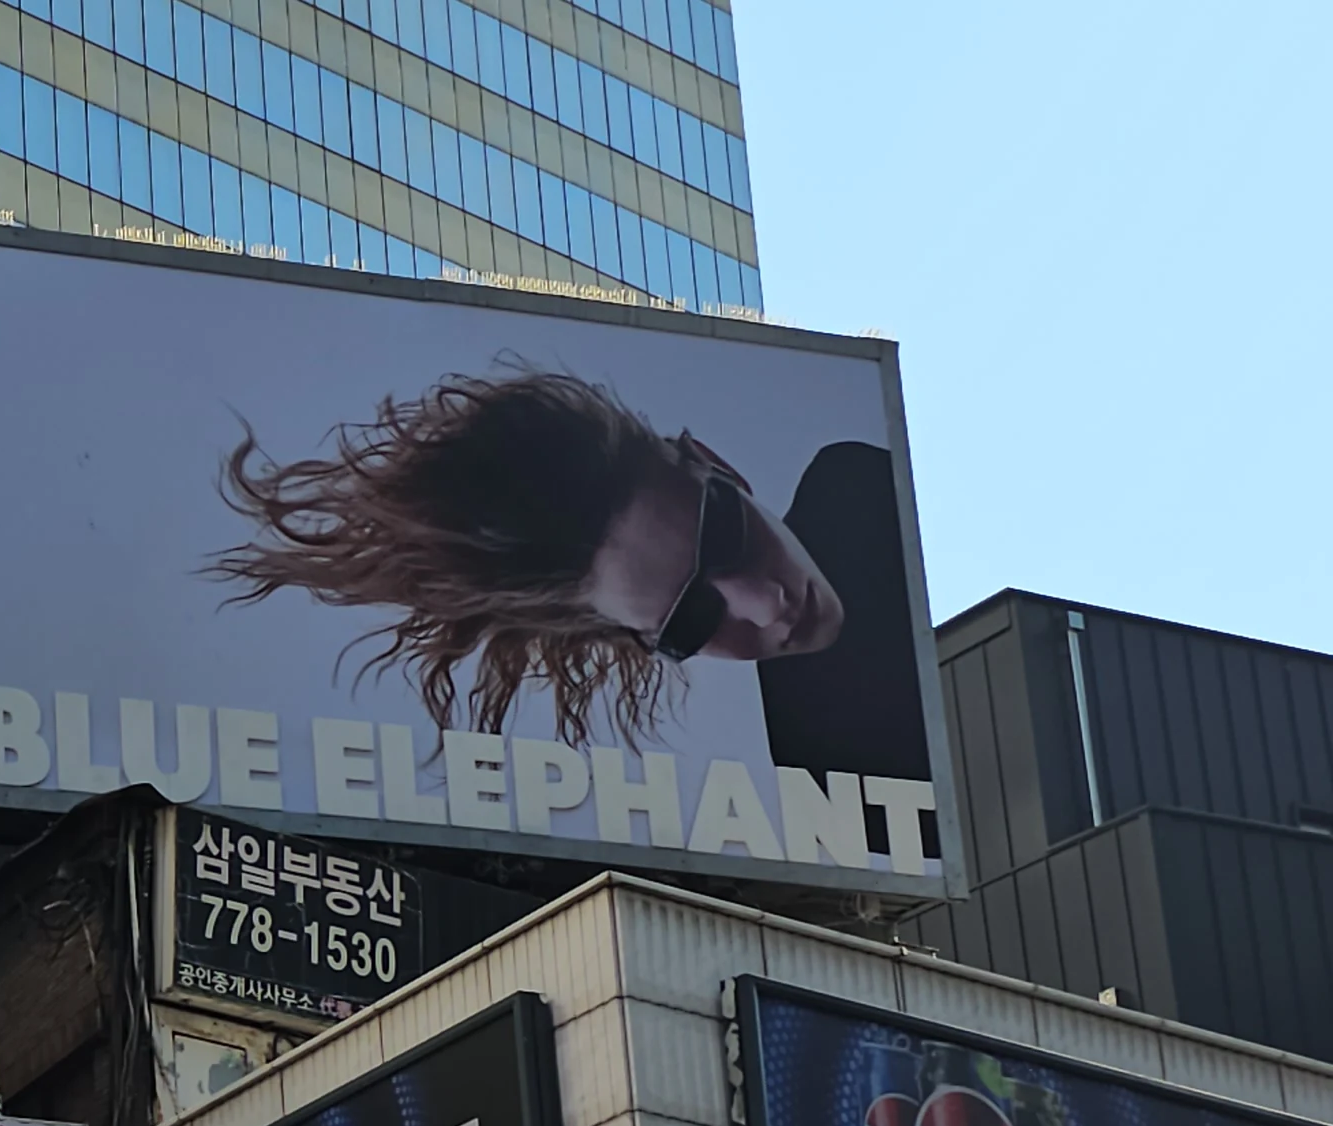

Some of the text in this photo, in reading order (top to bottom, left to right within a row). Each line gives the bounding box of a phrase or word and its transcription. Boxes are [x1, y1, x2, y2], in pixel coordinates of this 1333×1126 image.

[312, 717, 937, 876] ELEPHANT
[193, 824, 406, 927] 삼일부동산
[179, 963, 314, 1010] 공인중개사사무소
[201, 894, 396, 983] 778-1530
